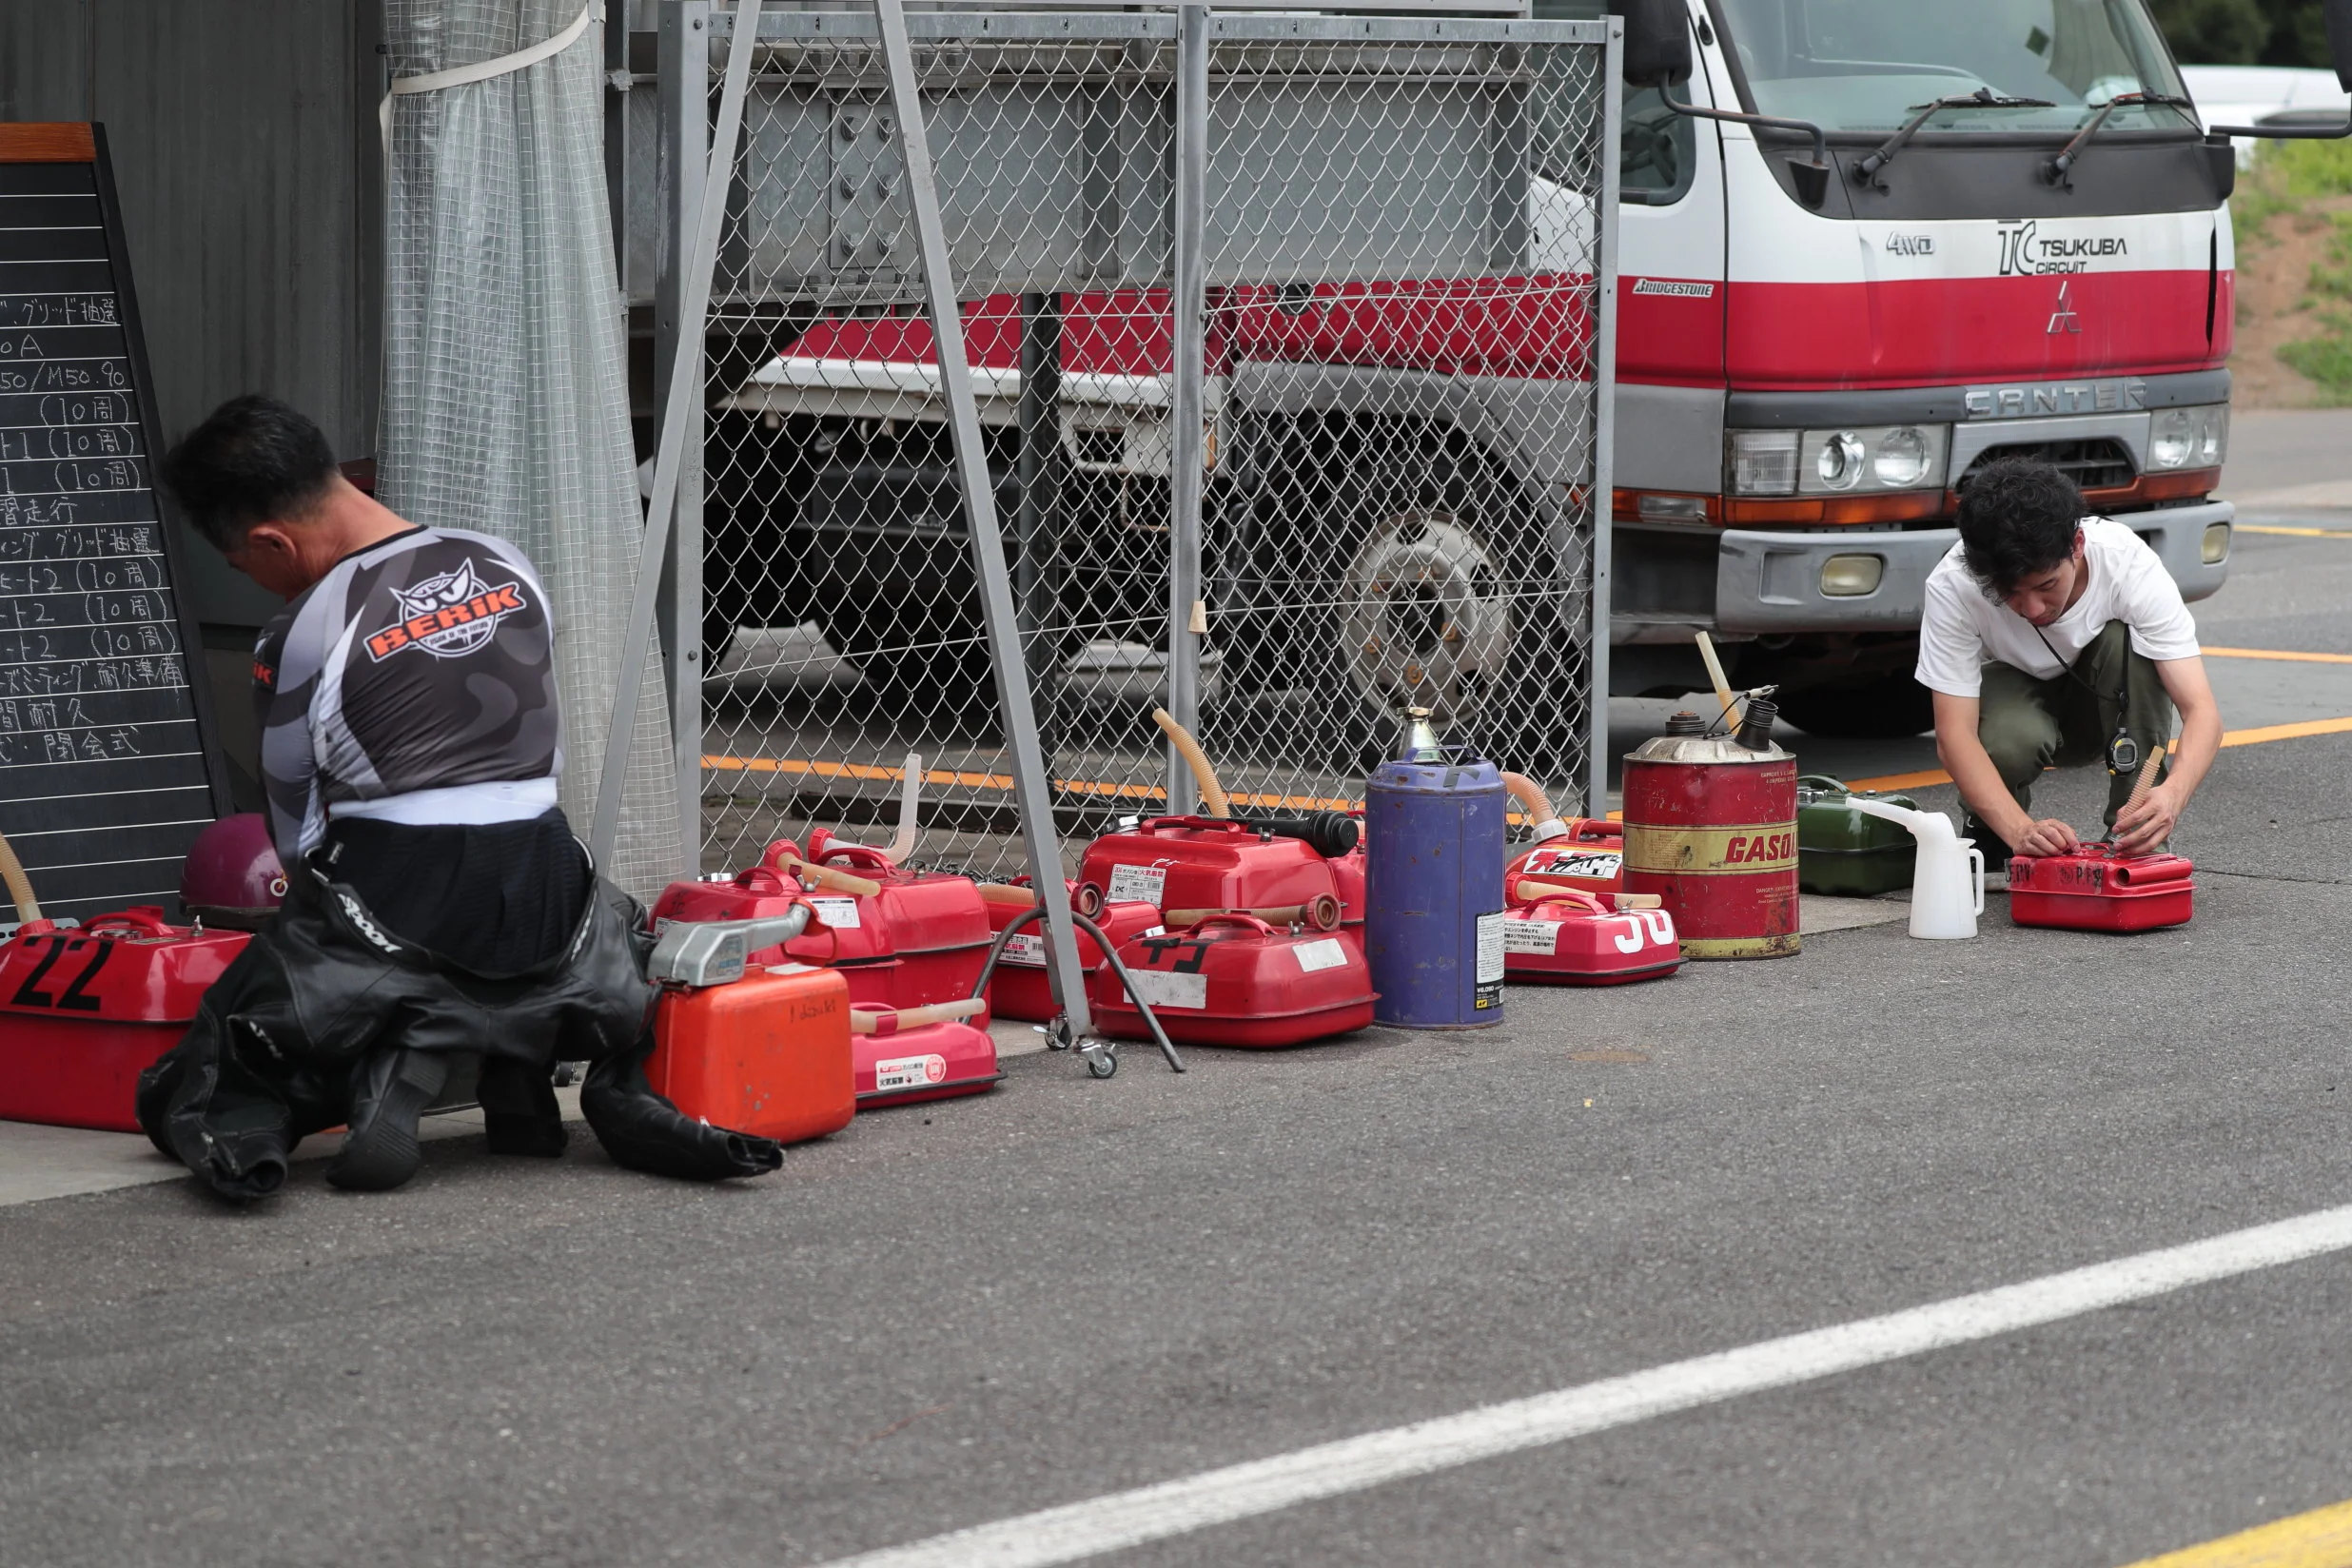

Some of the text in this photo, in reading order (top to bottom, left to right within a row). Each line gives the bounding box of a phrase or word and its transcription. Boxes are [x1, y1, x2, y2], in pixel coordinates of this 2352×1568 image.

[1886, 230, 1936, 256] 4WD
[2039, 237, 2127, 257] TSUKUBA
[1635, 279, 1713, 296] BRIDGESTONE
[1965, 381, 2147, 416] CANTER
[10, 934, 114, 1012] 22
